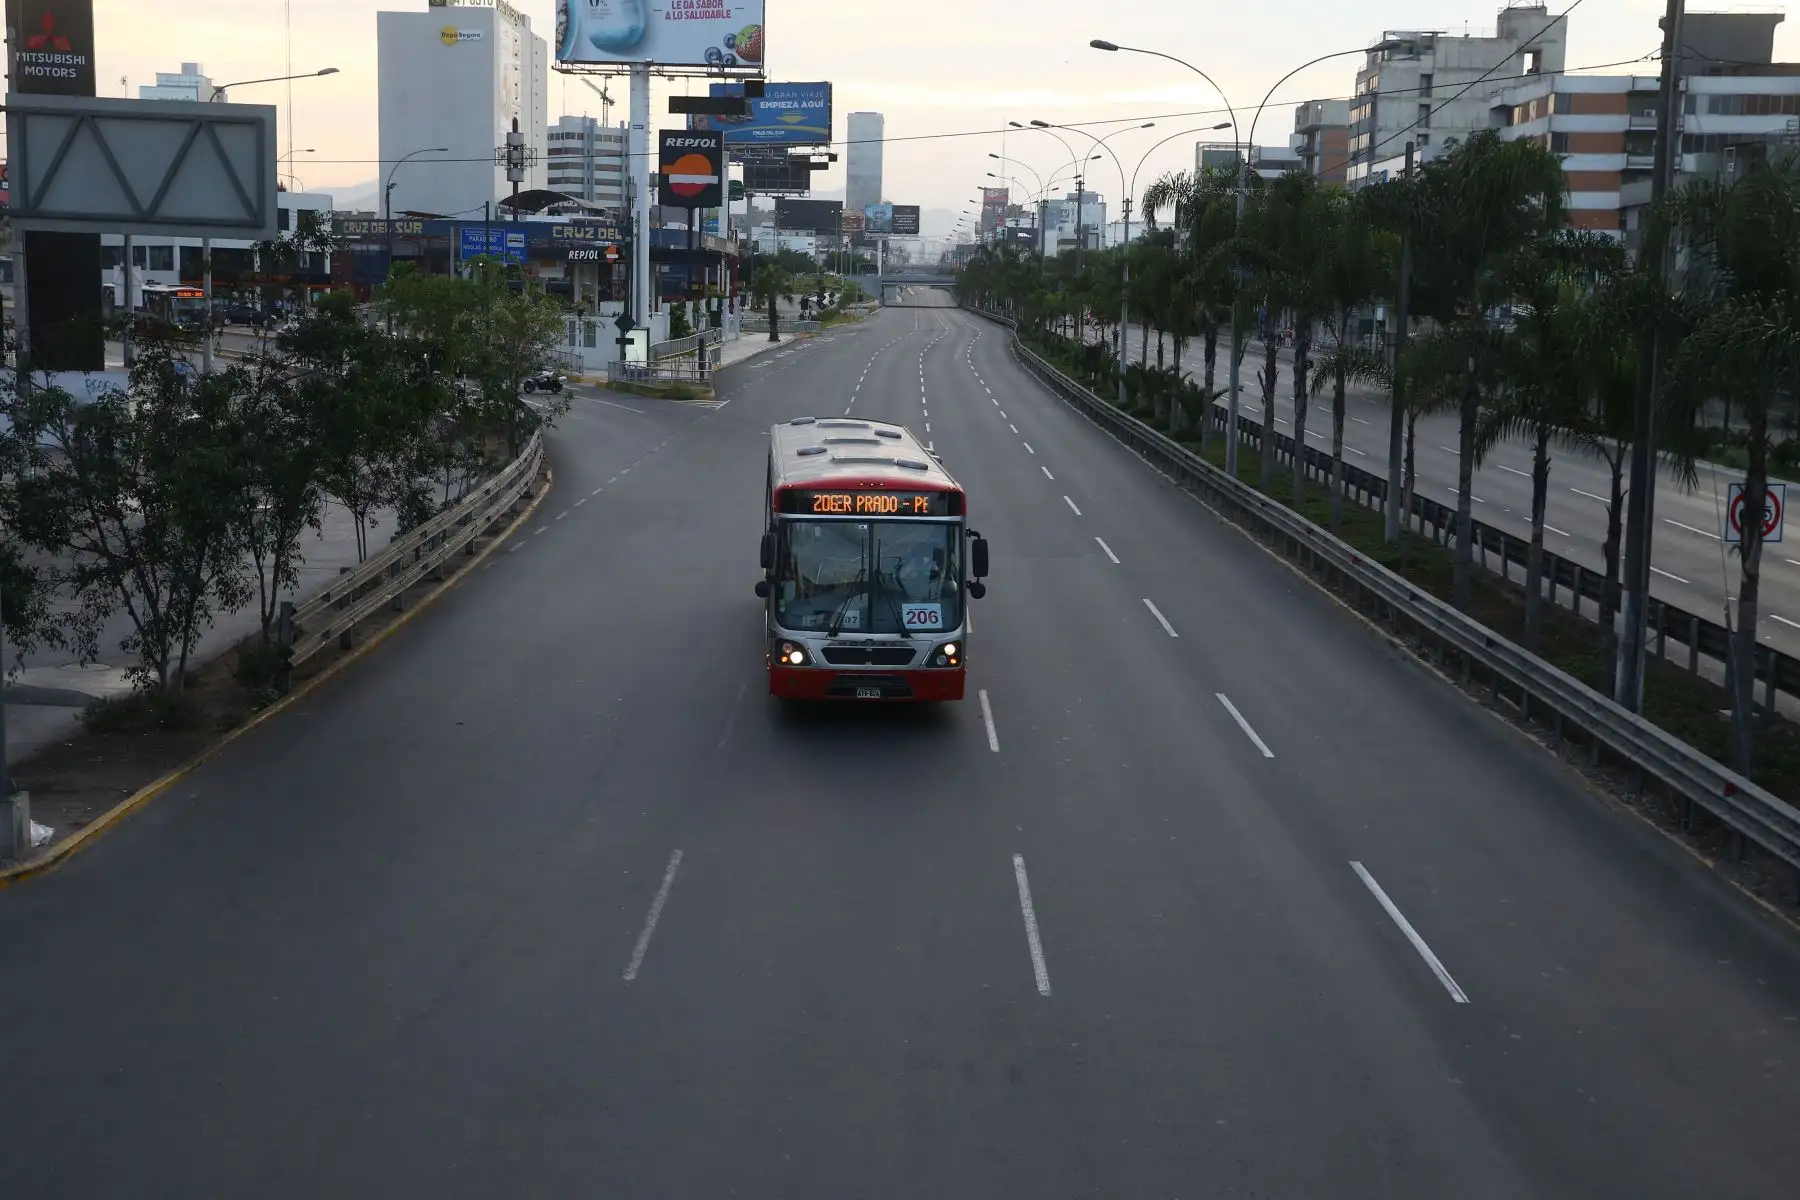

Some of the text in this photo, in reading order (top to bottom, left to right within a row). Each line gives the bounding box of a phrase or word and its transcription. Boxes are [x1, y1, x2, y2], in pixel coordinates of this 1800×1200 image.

[671, 0, 725, 9] LE DA SABOR
[665, 10, 732, 20] A LO SALUDABLE
[16, 52, 86, 65] MITSUBISHI
[25, 65, 77, 78] MOTORS
[774, 91, 798, 99] GRAN
[760, 99, 824, 109] EMPIEZA AQUÍ
[665, 137, 717, 148] REPSOL
[395, 221, 423, 234] SUR
[552, 225, 623, 240] CRUZ DEL
[568, 250, 599, 260] REPSOL
[856, 495, 898, 513] PRADO
[906, 611, 940, 625] 206
